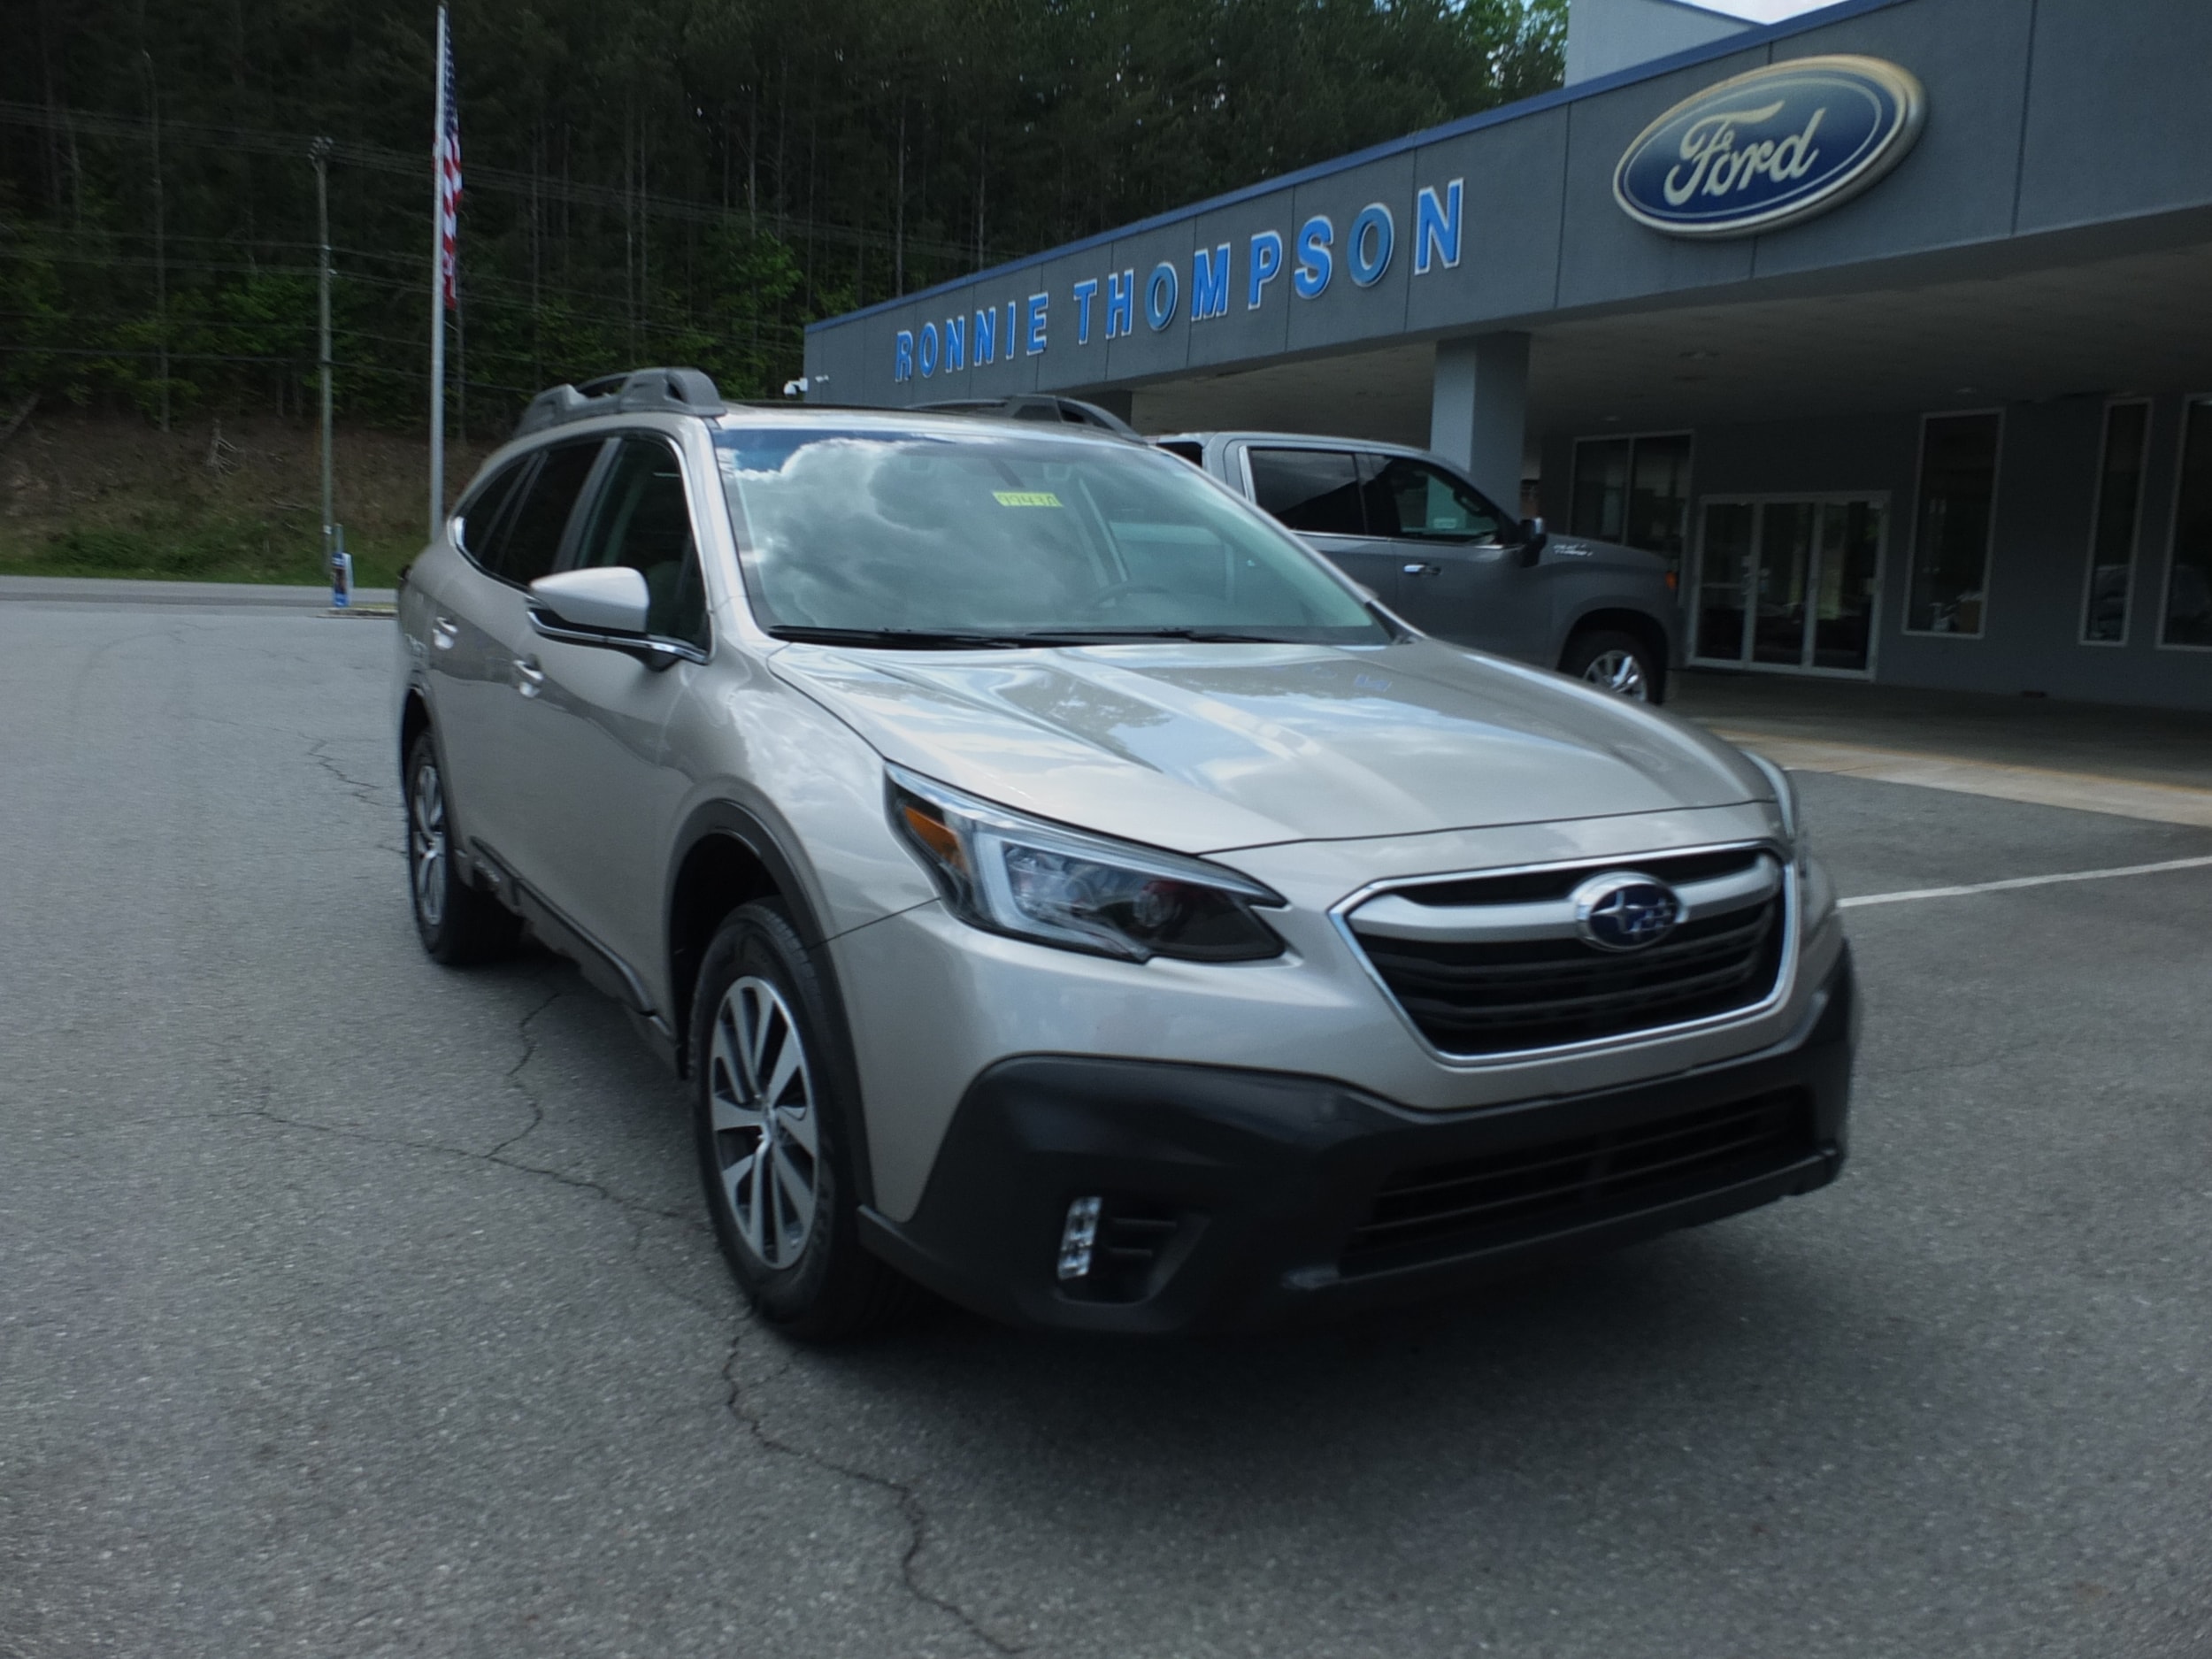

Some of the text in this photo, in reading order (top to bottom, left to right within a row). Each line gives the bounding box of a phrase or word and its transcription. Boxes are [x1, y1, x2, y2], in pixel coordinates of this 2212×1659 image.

[1663, 100, 1826, 206] Ford
[895, 177, 1464, 383] RONNIE THOMPSON
